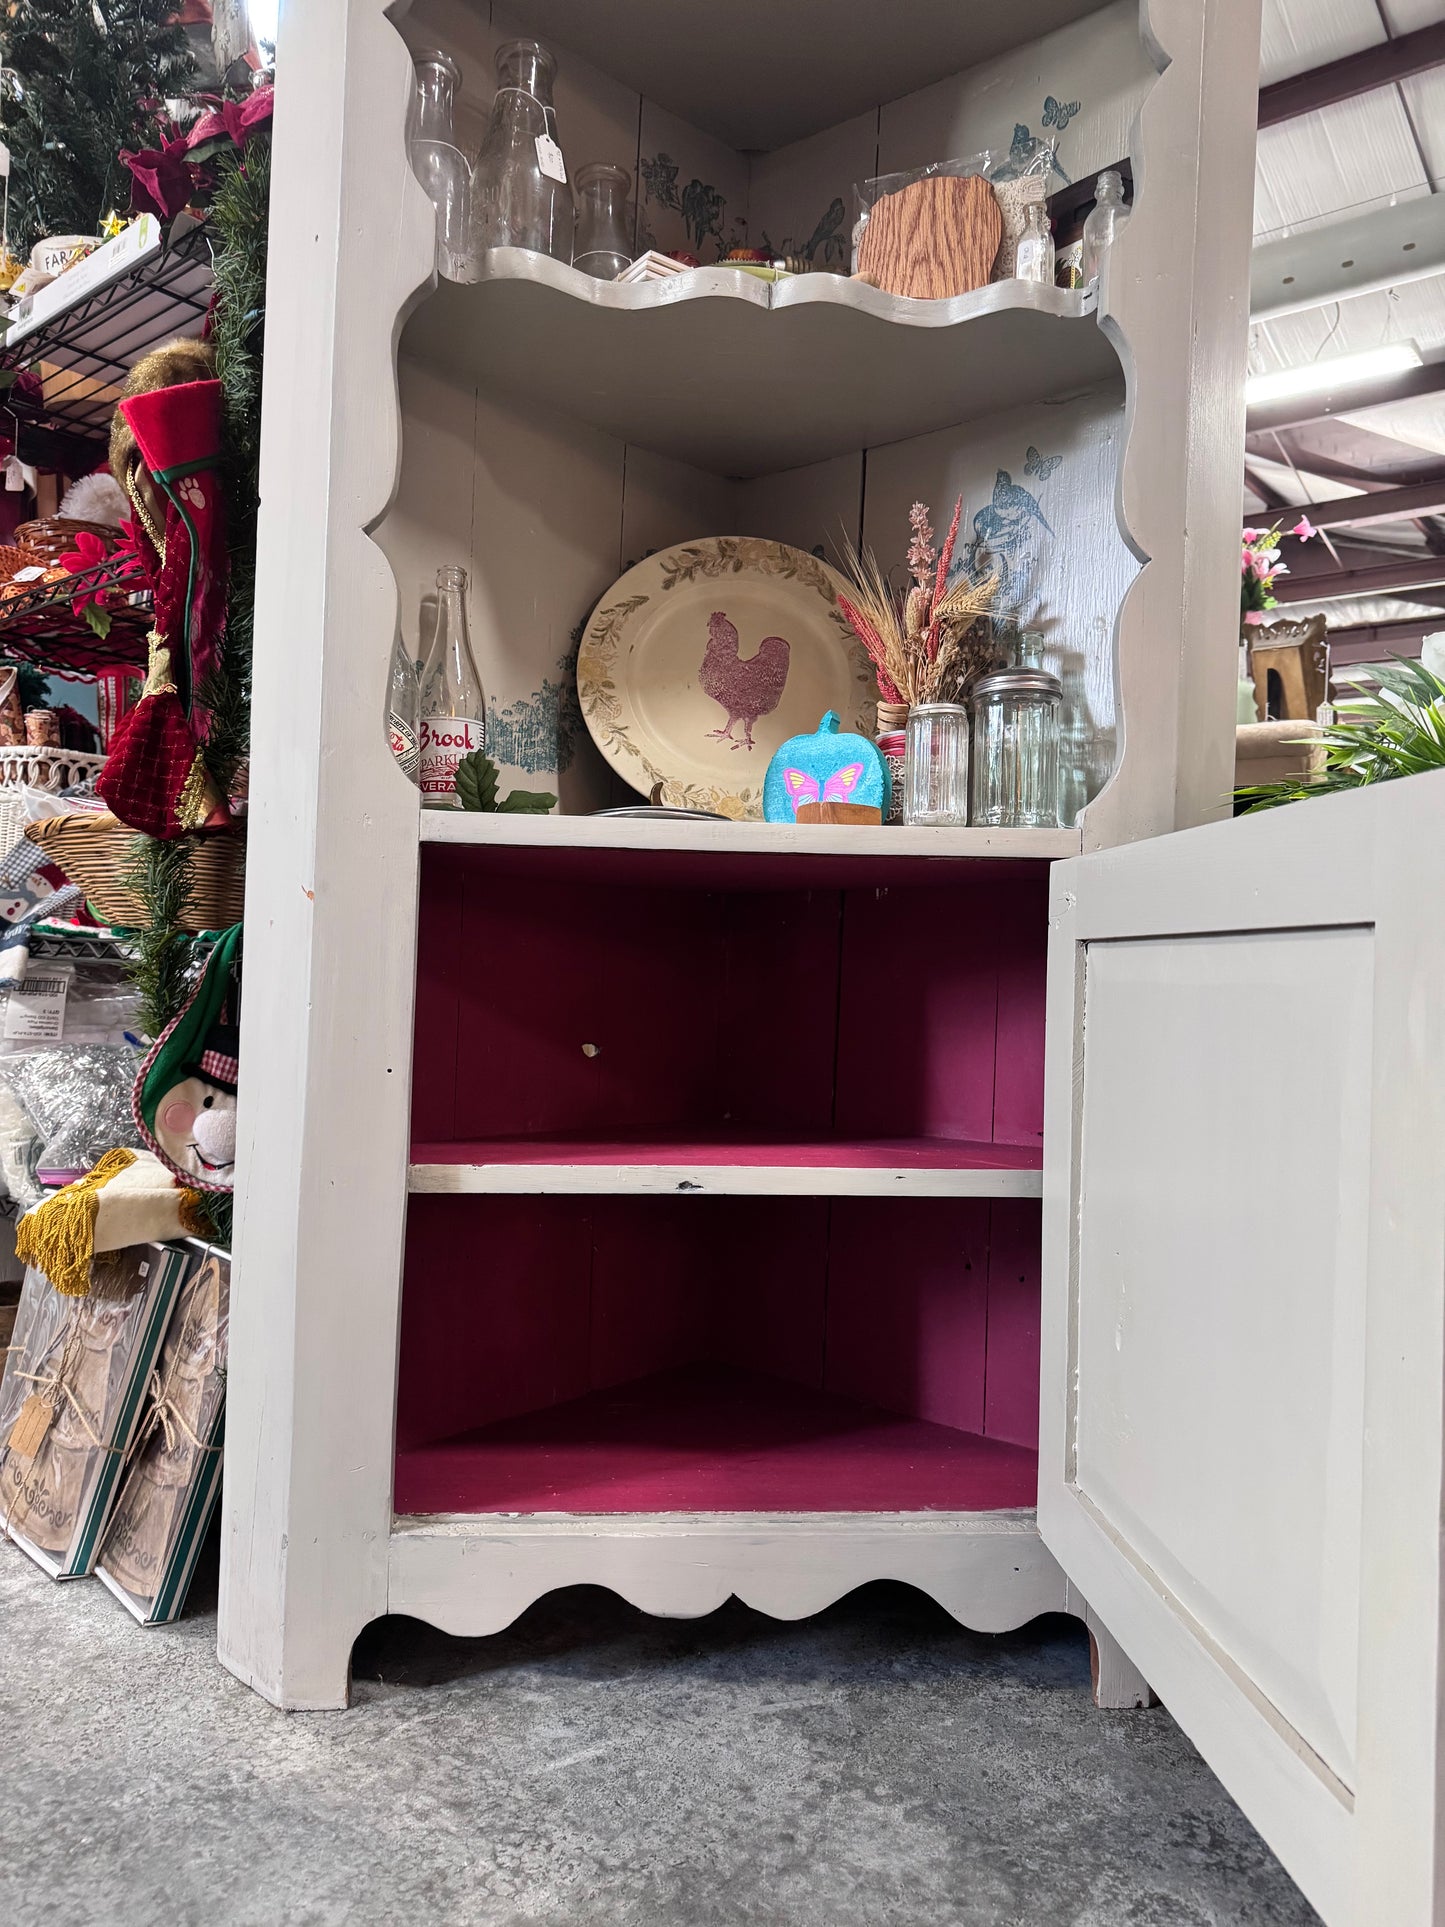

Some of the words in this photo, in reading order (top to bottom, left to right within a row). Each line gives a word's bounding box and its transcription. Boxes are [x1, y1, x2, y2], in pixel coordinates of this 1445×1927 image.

[45, 249, 73, 270] FAR
[420, 721, 475, 753] Brook
[422, 781, 457, 791] VERA
